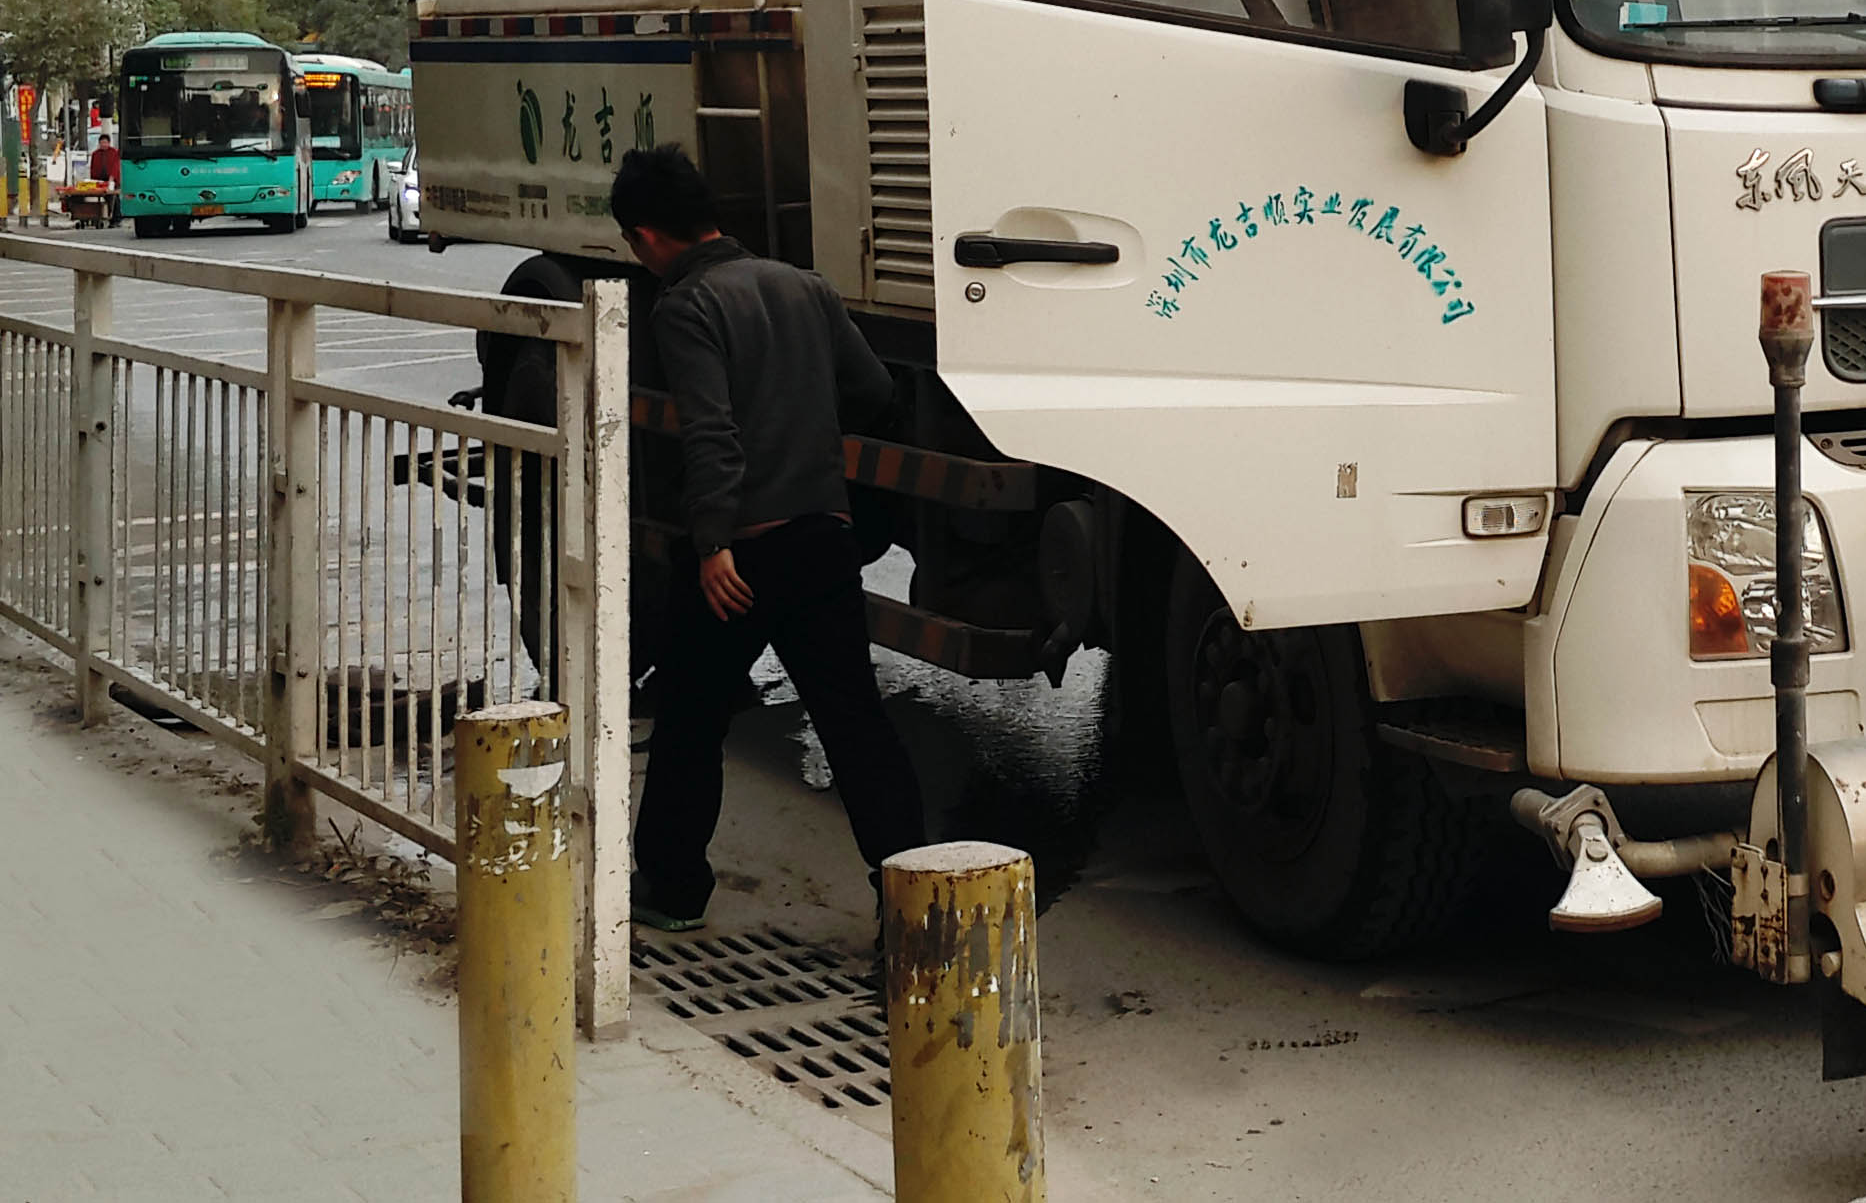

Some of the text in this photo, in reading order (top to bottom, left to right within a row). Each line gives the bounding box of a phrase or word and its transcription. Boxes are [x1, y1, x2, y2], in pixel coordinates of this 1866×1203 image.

[1145, 186, 1475, 324] 深圳市龙吉顺实业发展有限公司
